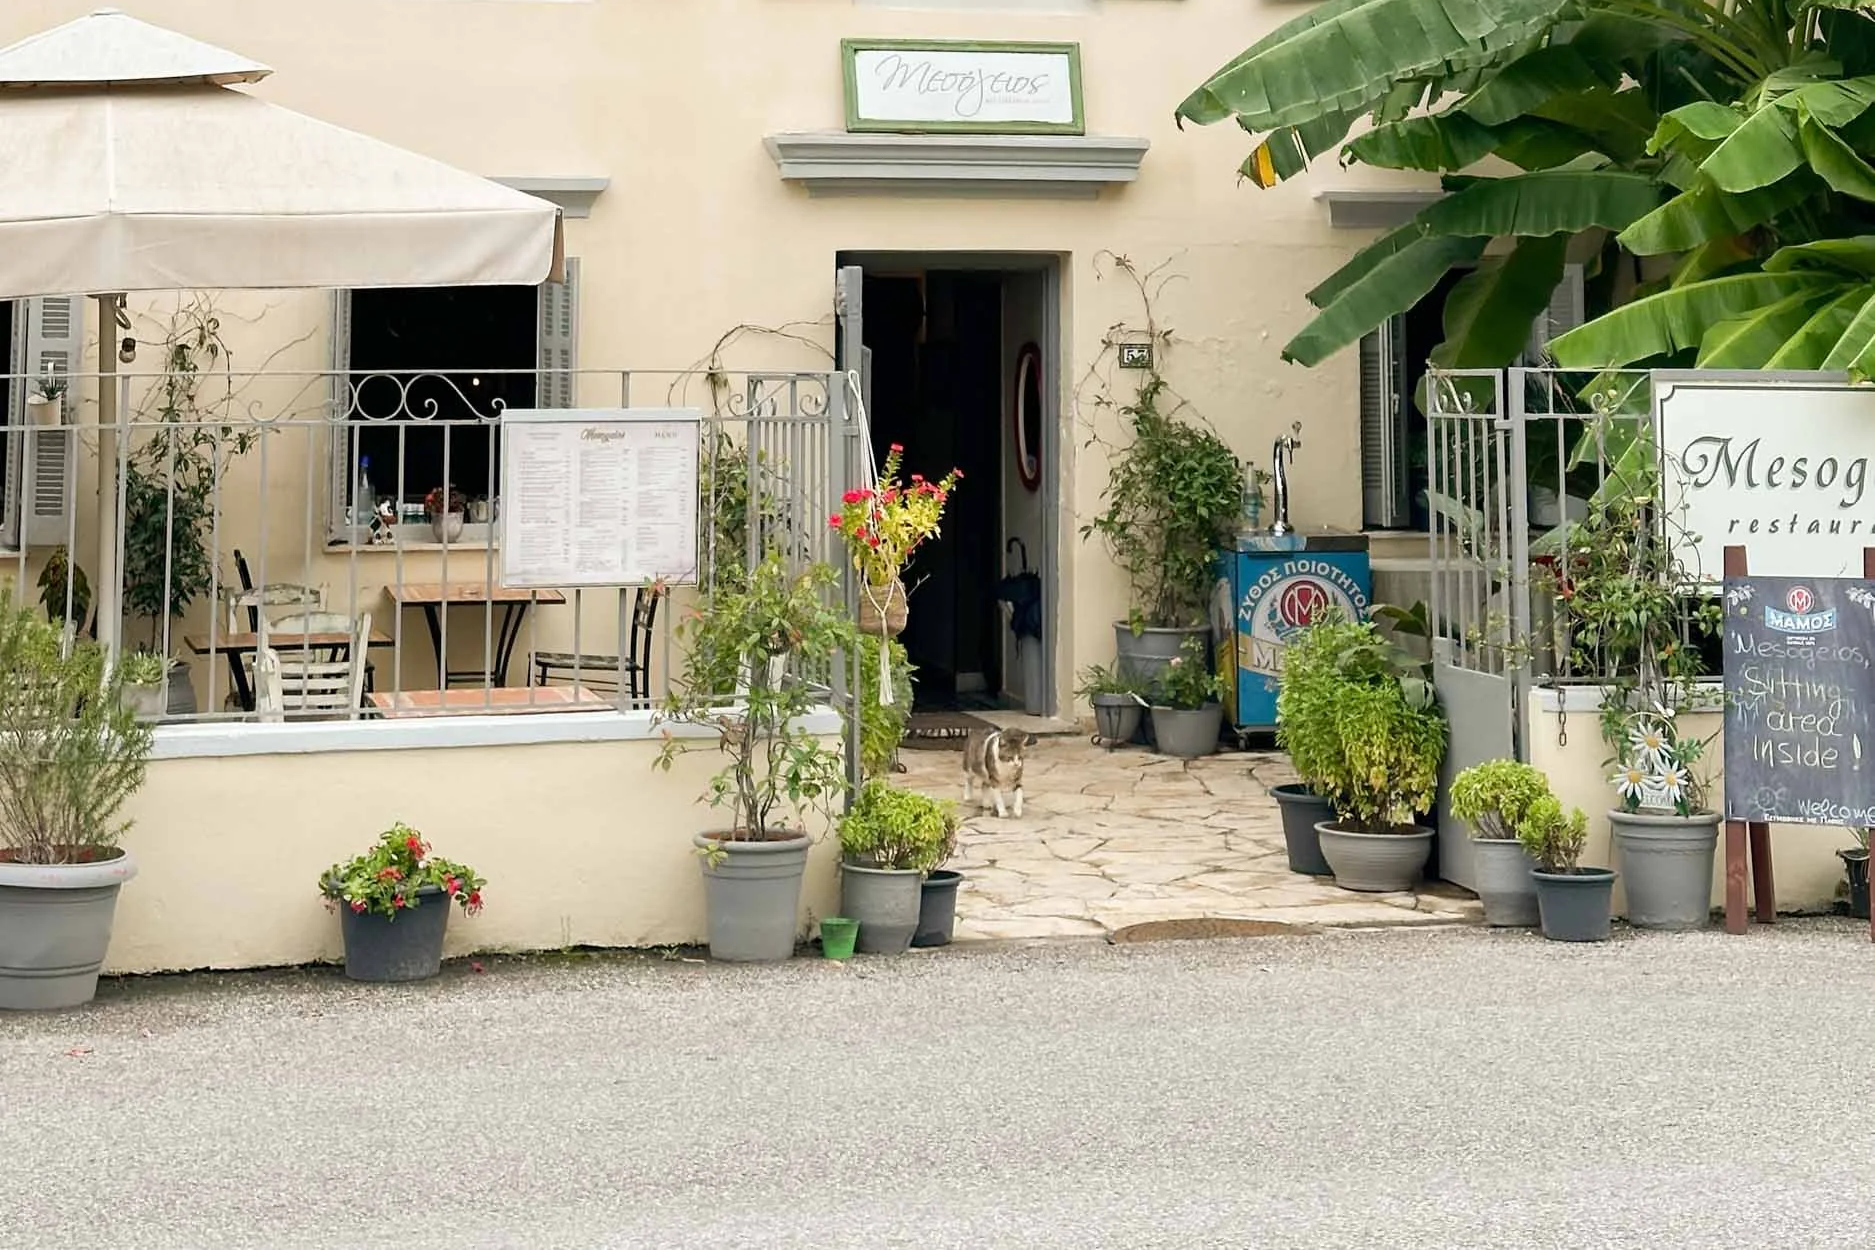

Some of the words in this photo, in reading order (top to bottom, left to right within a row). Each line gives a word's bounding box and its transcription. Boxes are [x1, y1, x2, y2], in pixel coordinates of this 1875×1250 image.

[1682, 436, 1869, 508] Mesog
[1728, 513, 1875, 534] restaur
[1766, 710, 1843, 737] area
